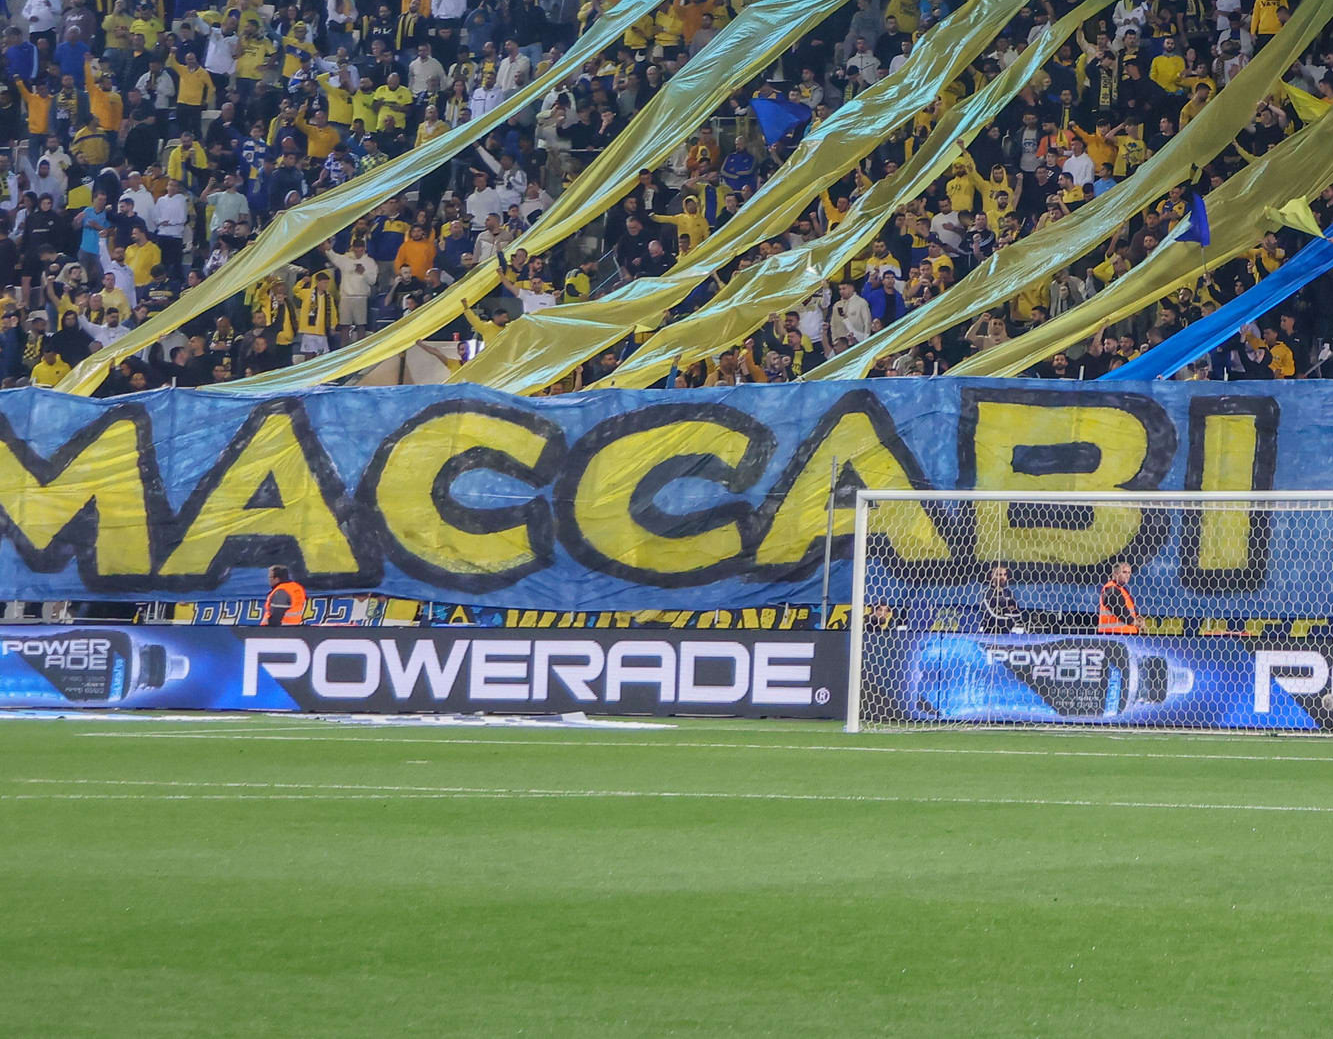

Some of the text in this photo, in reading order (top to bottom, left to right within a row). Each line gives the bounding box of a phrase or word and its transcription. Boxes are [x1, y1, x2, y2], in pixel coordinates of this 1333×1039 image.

[0, 388, 1278, 594] MACCABI
[2, 638, 111, 655] POWER
[44, 655, 108, 670] ADE
[986, 648, 1105, 665] POWER
[1032, 665, 1101, 682] ADE
